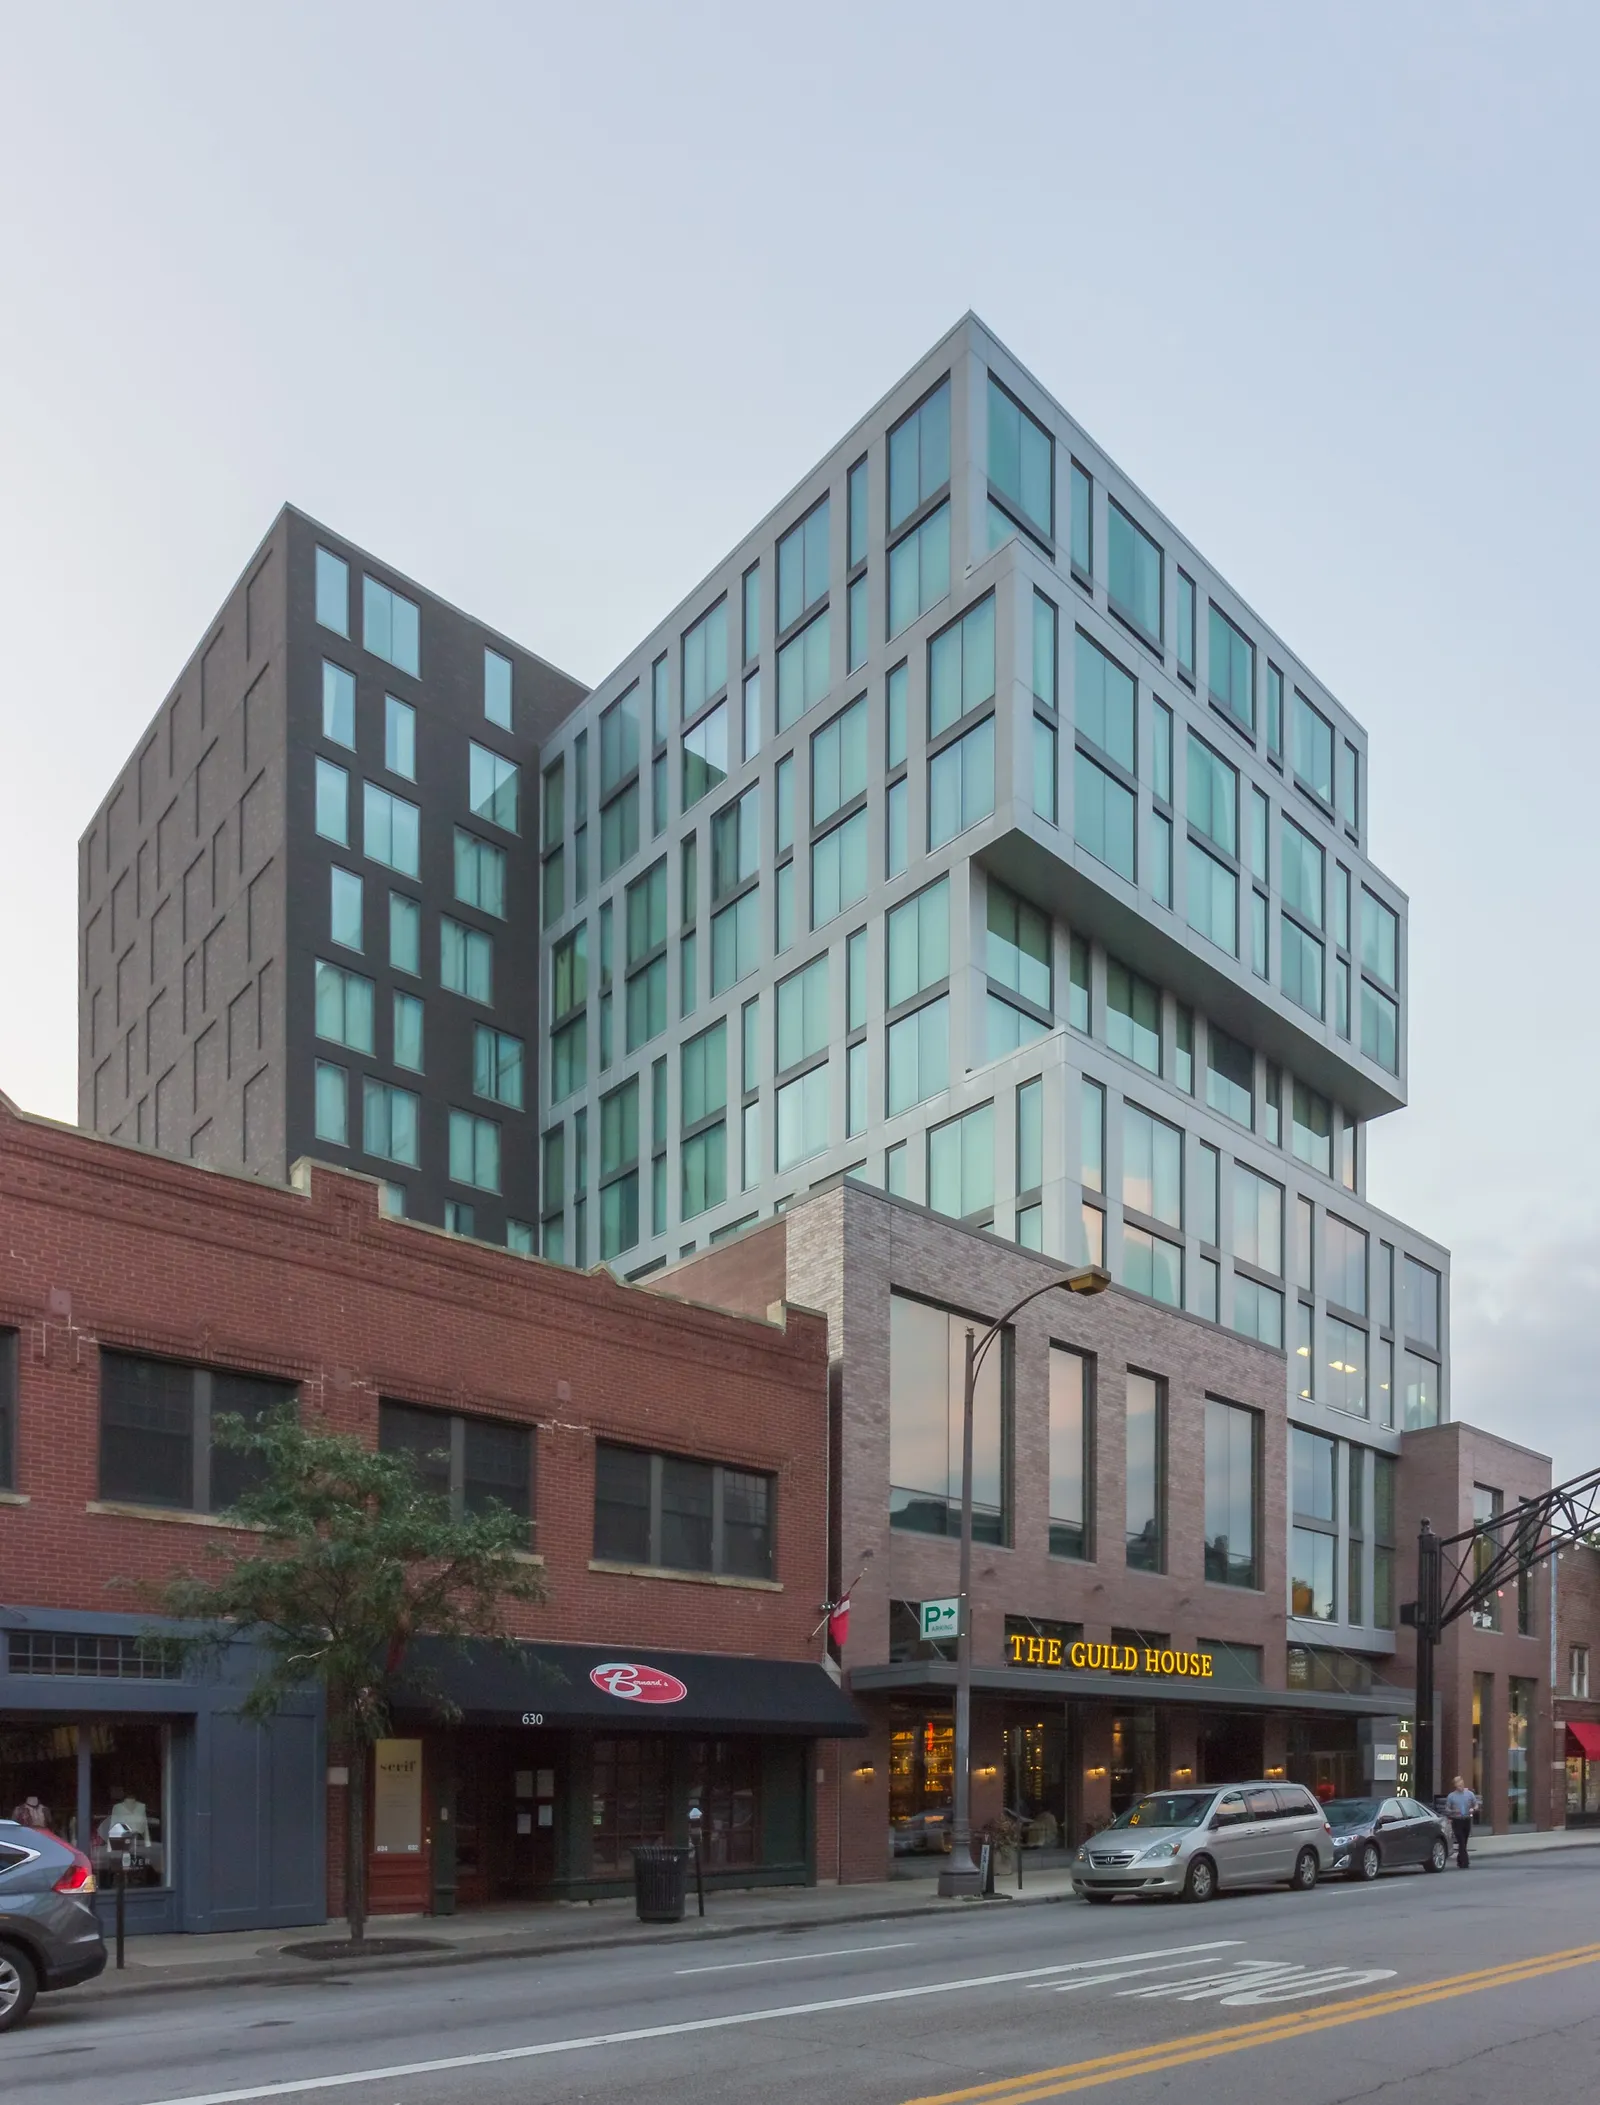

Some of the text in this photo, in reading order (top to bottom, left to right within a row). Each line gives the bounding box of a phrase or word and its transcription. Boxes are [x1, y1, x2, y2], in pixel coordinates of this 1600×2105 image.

[1010, 1635, 1214, 1677] THE GUILD HOUSE
[522, 1713, 544, 1725] 630
